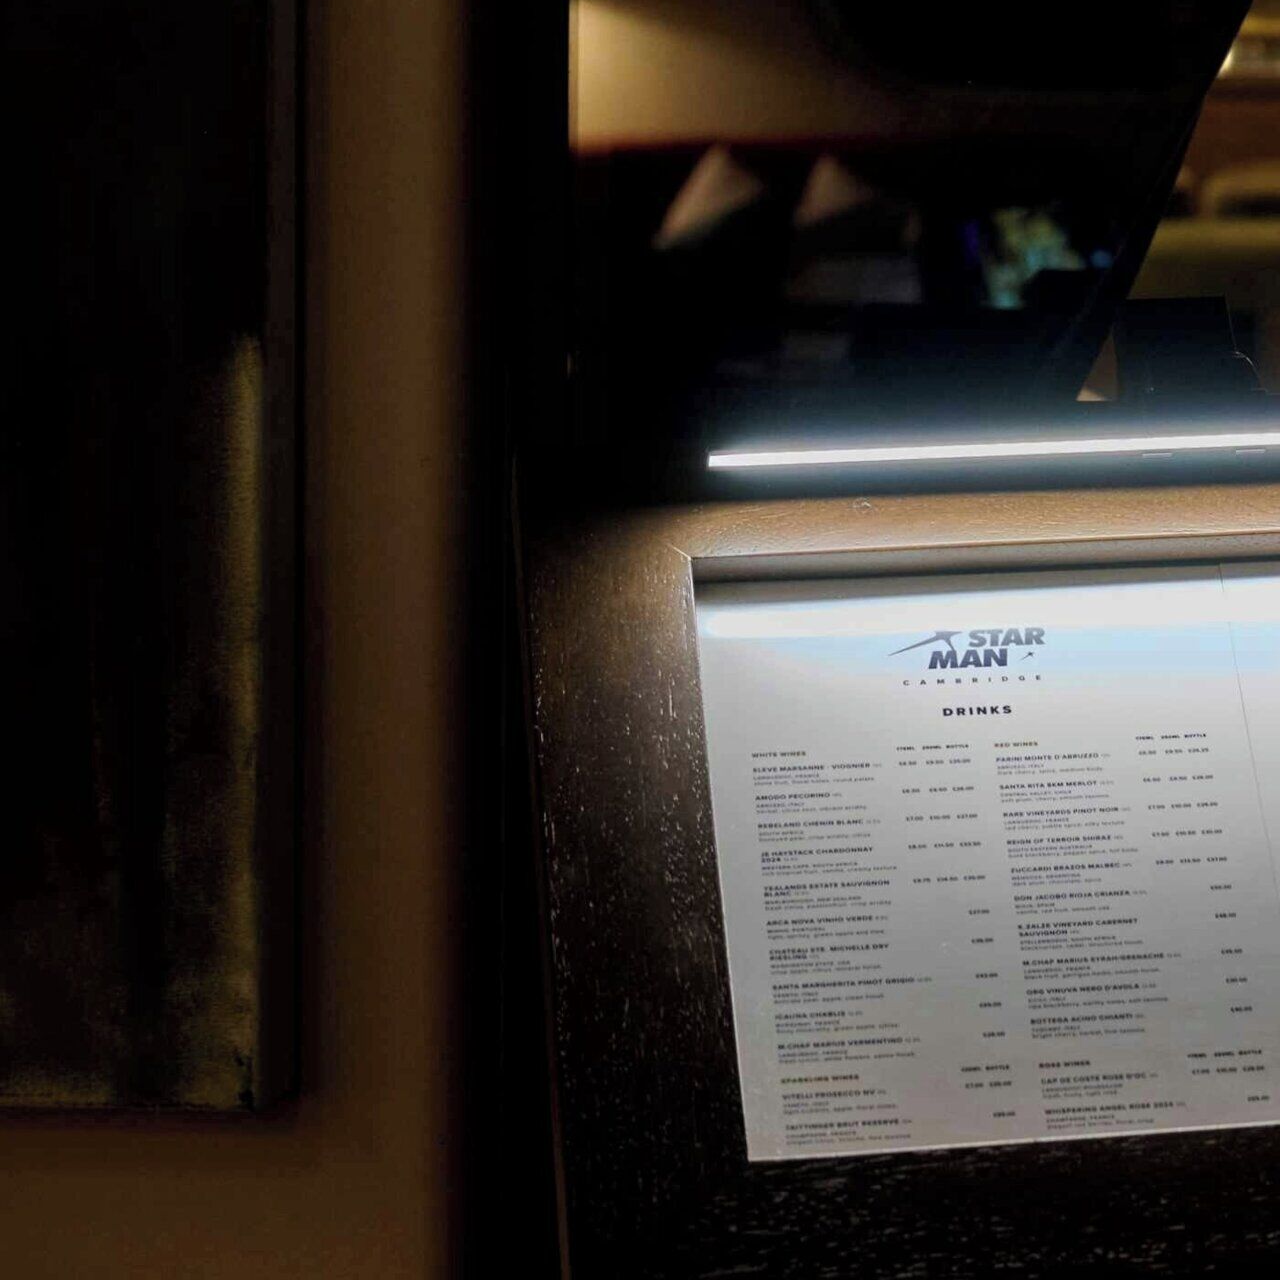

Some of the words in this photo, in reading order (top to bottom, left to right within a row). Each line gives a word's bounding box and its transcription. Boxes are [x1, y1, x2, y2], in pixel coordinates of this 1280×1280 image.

[968, 627, 1046, 648] STAR
[928, 648, 1009, 669] MAN
[902, 675, 1042, 686] CAMBRIDGE
[942, 705, 1012, 717] DRINKS
[1013, 740, 1038, 748] WINES
[831, 762, 871, 770] VIOGNIER
[1002, 810, 1025, 818] RARE
[1026, 808, 1071, 817] VINEYARDS
[1006, 838, 1032, 846] REIGN
[1047, 836, 1080, 844] TERROIR
[1082, 834, 1111, 842] SHIRAZ
[771, 848, 814, 857] HAYSTACK
[815, 845, 873, 855] CHARDONNAY
[841, 879, 890, 888] SAUVIGNON
[816, 916, 844, 924] VINHO
[1053, 919, 1094, 928] VINEYARD
[1095, 917, 1138, 926] CABERNET
[1018, 929, 1068, 937] SAUVIGNON
[772, 983, 800, 991] SANTA
[801, 980, 856, 989] MARGHERITA
[857, 978, 883, 986] PINOT
[780, 1075, 830, 1084] SPARKLING
